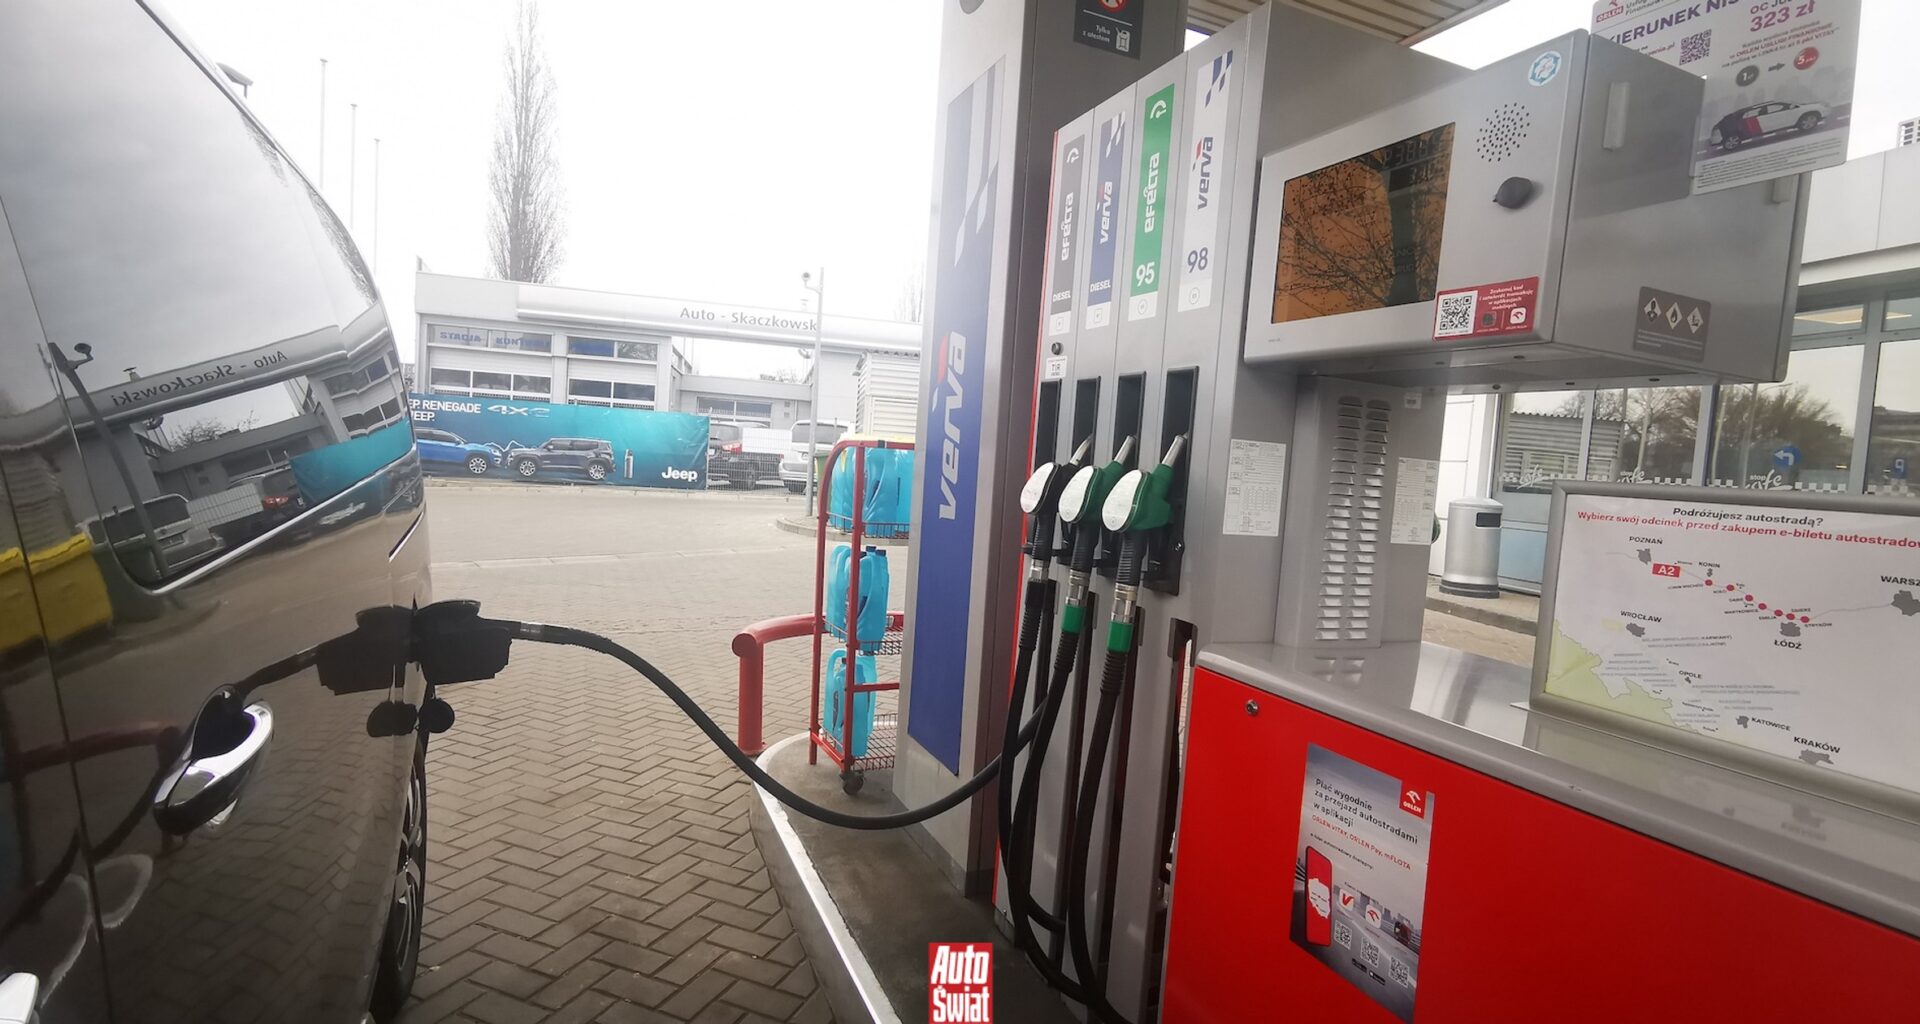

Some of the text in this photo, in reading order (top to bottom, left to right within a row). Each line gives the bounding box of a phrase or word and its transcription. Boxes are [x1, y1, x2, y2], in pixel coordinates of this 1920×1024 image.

[1609, 4, 1701, 44] IERUNEK
[1750, 0, 1815, 32] 323 zł
[1197, 136, 1214, 211] verva
[1144, 152, 1160, 234] efecta
[1099, 180, 1114, 245] verva
[1061, 191, 1074, 262] efecta
[1187, 246, 1209, 273] 98
[1136, 261, 1155, 287] 95
[1052, 290, 1072, 303] DIESEL
[1089, 279, 1111, 294] DIESEL
[680, 307, 715, 321] Auto
[731, 311, 818, 332] Skaczkowsk
[422, 400, 481, 414] RENEGADE
[938, 331, 967, 521] verva
[661, 466, 698, 482] Jeep
[1577, 511, 1614, 522] Wybierz
[1616, 515, 1639, 525] swój
[1641, 517, 1683, 528] odcinek
[1685, 521, 1719, 531] przed
[1721, 523, 1777, 536] zakupem
[1779, 528, 1833, 540] e-biletu
[1673, 507, 1824, 528] Podróżujesz autostradą?
[1629, 536, 1663, 545] POZNAŃ
[1657, 566, 1675, 576] A2
[1698, 561, 1721, 569] KONIN
[1620, 610, 1662, 623] WROCŁAW
[1678, 670, 1703, 680] OPOLE
[1751, 717, 1791, 731] KATOWICE
[1793, 736, 1841, 754] KRAKÓW
[1334, 788, 1372, 811] wygodnie
[1403, 801, 1422, 814] ORLEN
[1314, 790, 1418, 844] za przejazd autostradami
[1321, 806, 1354, 828] aplikacji
[1312, 814, 1331, 828] ORLEN
[1349, 834, 1370, 849] ORLEN
[1384, 853, 1411, 870] mFLOTA
